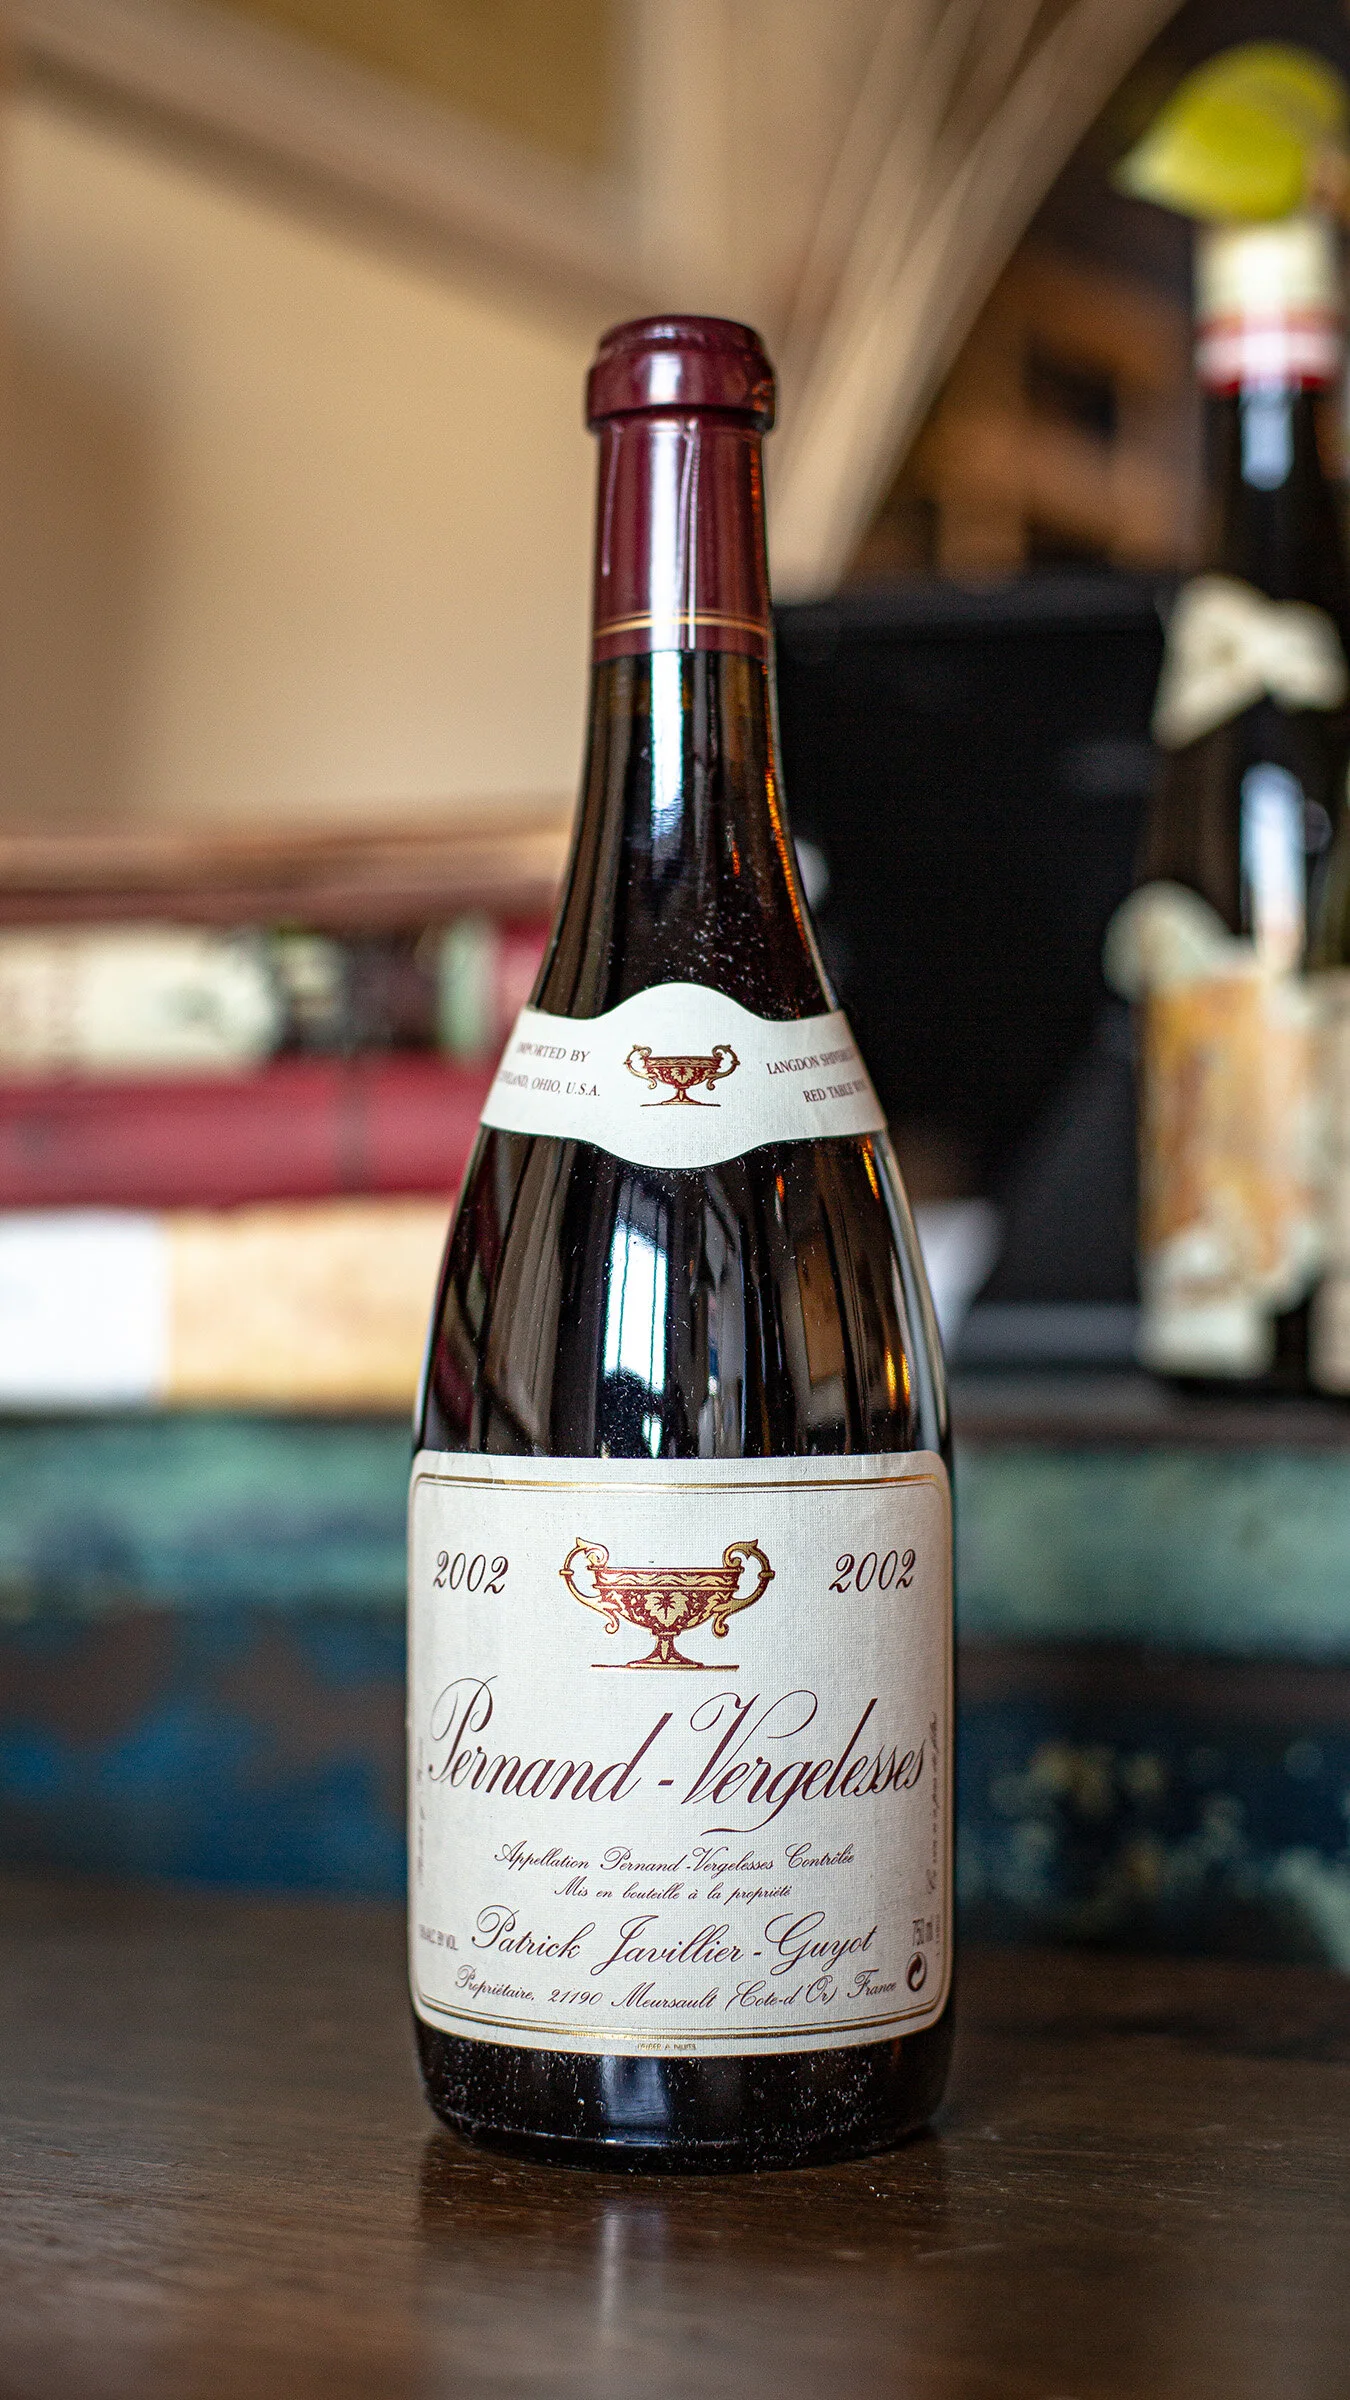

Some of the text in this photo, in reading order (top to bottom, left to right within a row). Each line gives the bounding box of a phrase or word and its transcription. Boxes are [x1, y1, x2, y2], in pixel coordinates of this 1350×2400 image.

[570, 1049, 590, 1062] BY
[766, 1055, 820, 1074] LANGDON
[531, 1077, 561, 1094] OHIO,
[566, 1081, 600, 1096] U.S.A.
[803, 1088, 826, 1103] RED
[827, 1082, 855, 1099] TABLE
[433, 1550, 509, 1595] 2002
[828, 1548, 916, 1594] 2002
[494, 1840, 590, 1871] Appellation
[554, 1875, 793, 1906] Mis en bouteille à la propriété
[471, 1904, 596, 1959] Patrick
[547, 1988, 604, 2005] 21190
[610, 1981, 720, 2009] Meursault
[847, 1968, 897, 1998] France
